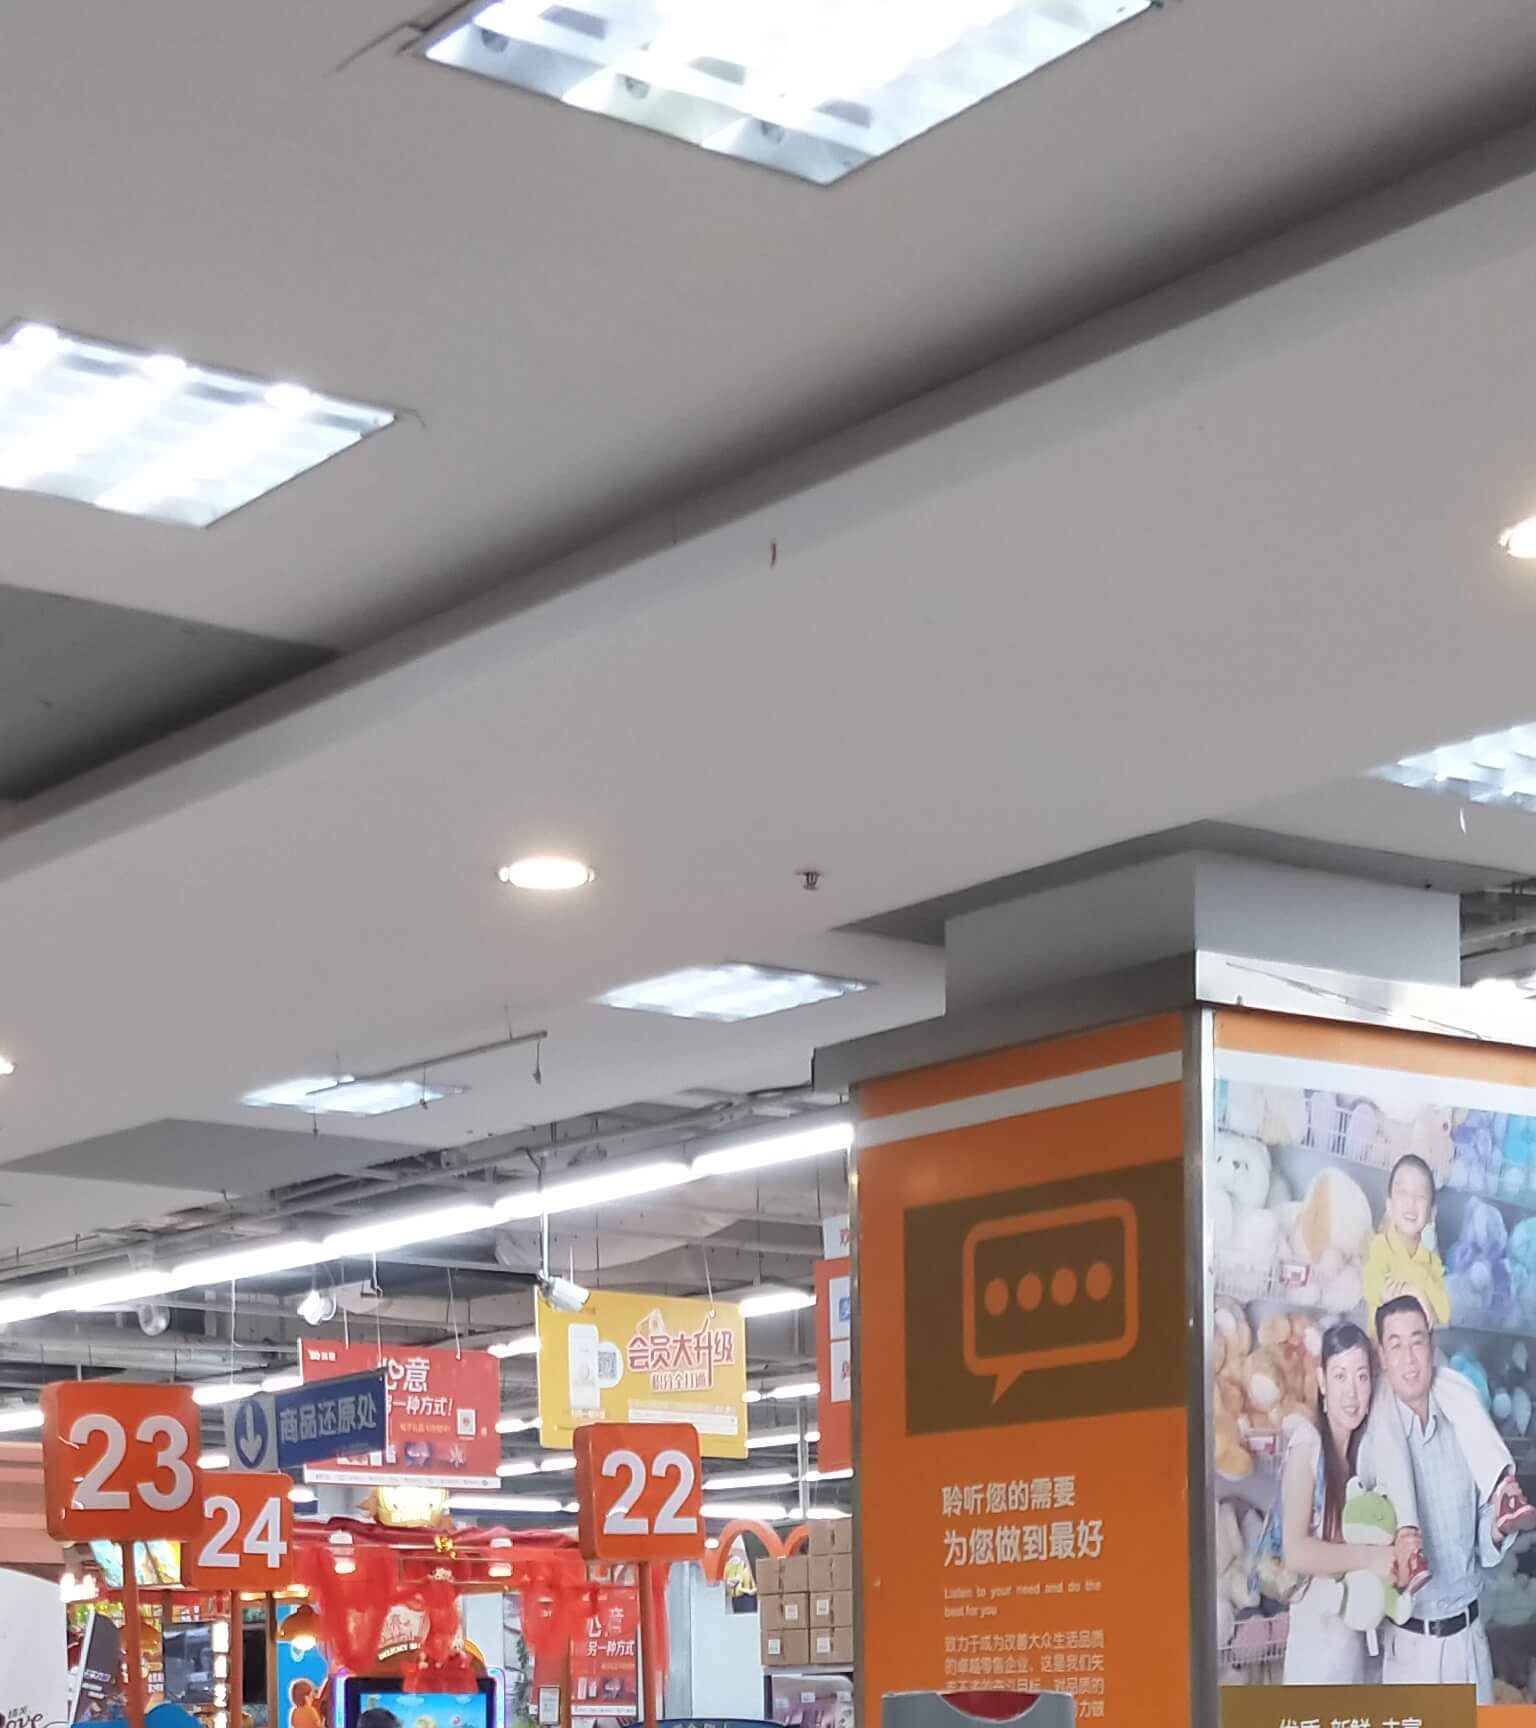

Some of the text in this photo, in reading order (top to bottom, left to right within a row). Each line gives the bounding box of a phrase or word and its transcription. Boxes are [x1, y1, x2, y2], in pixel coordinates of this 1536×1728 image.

[627, 1320, 736, 1372] 会员大升级
[279, 1393, 377, 1445] 商品还原处
[67, 1413, 195, 1513] 23
[601, 1449, 697, 1536] 22
[942, 1475, 1076, 1517] 聆听您的需要
[198, 1495, 287, 1568] 24
[943, 1519, 1105, 1568] 为您做到最好
